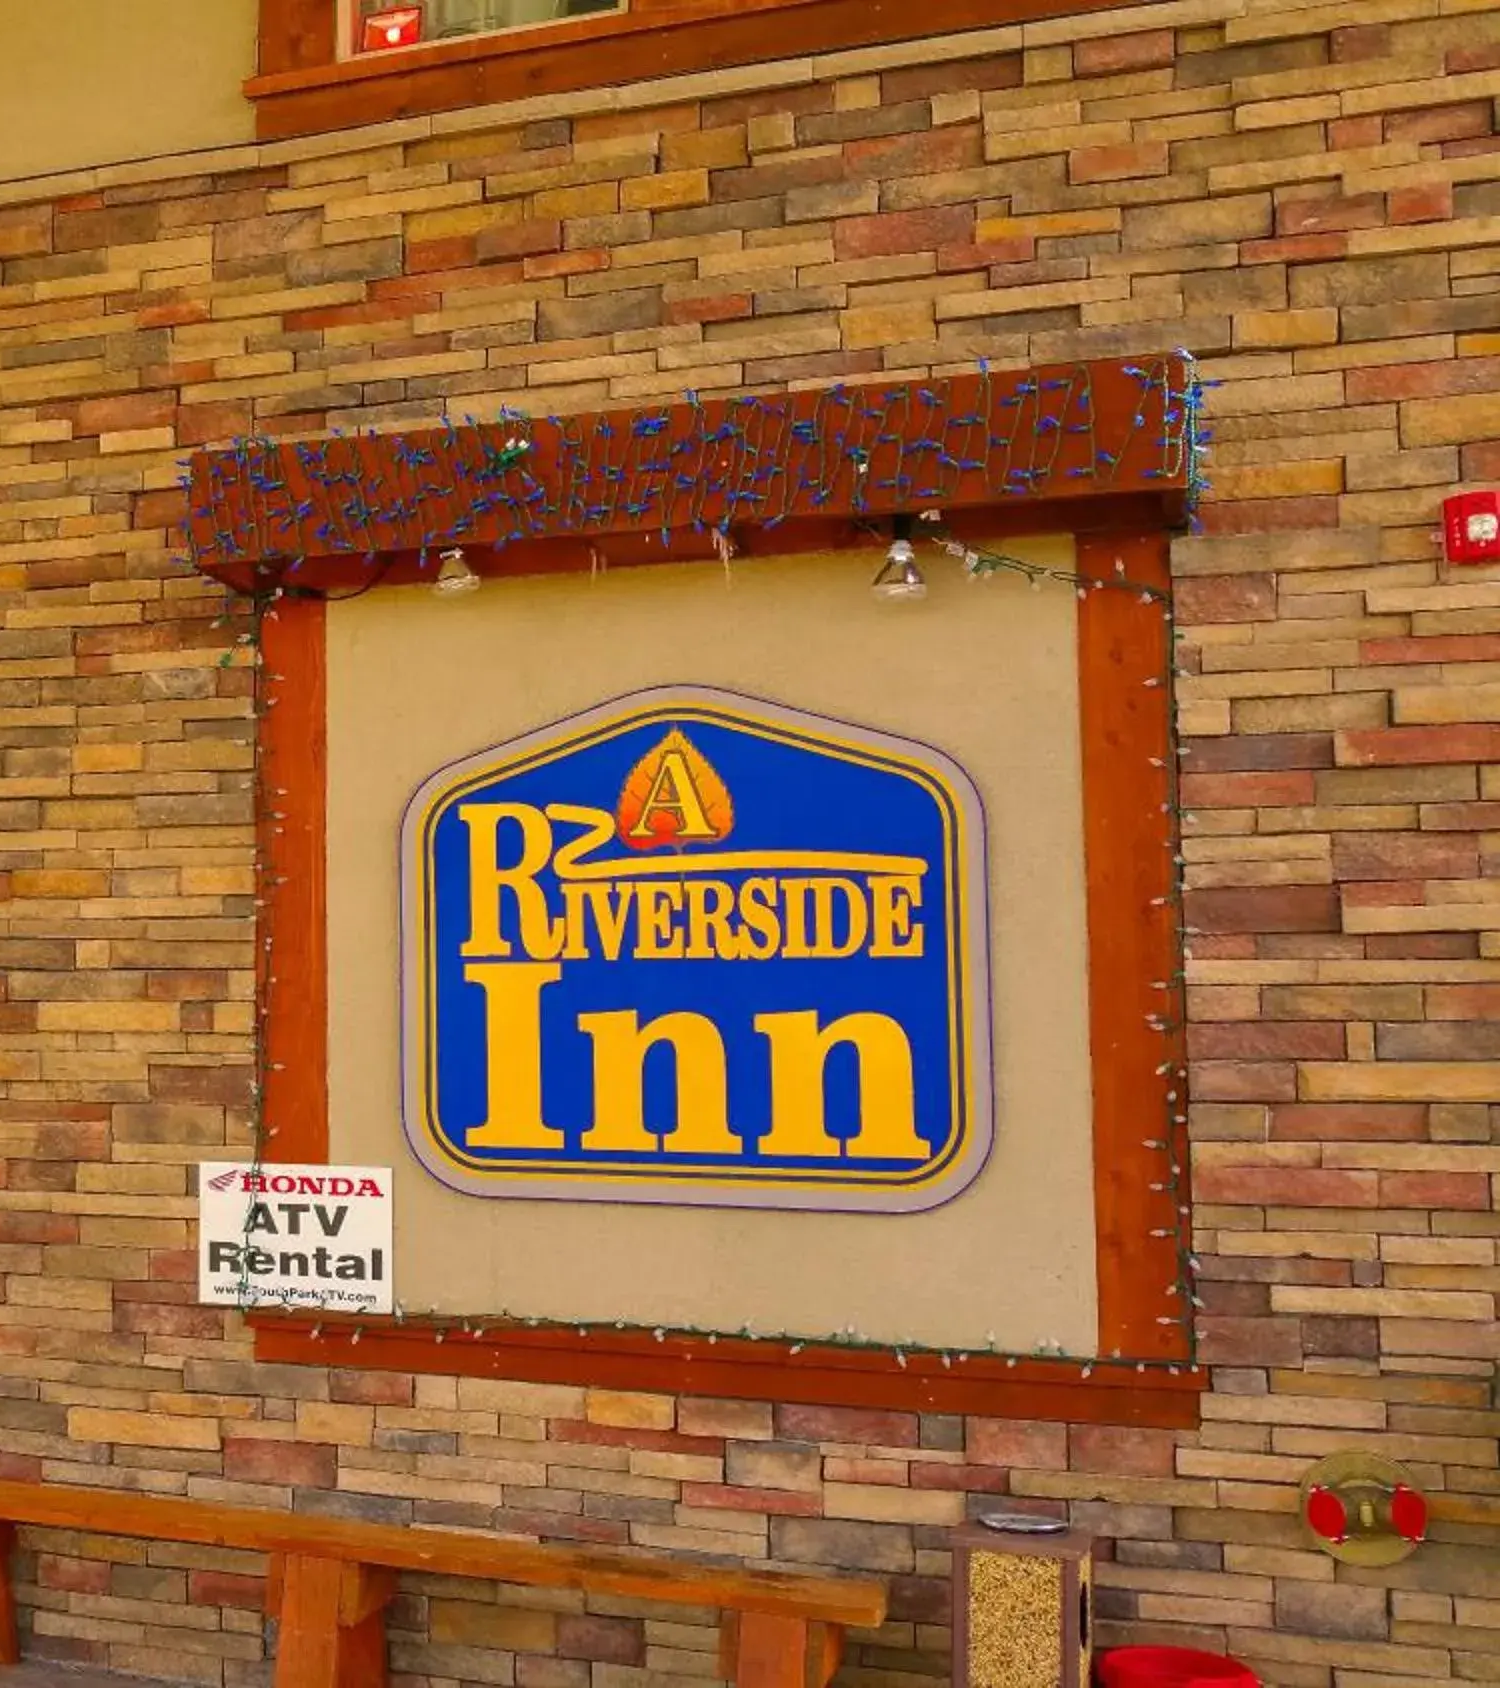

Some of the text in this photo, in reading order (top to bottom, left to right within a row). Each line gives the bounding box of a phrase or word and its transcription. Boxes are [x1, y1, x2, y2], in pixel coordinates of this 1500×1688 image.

[629, 750, 720, 840] A
[457, 801, 926, 961] RIVERSIDE
[463, 961, 931, 1160] Inn
[240, 1170, 385, 1199] HONDA
[244, 1202, 349, 1237] ATV
[208, 1240, 384, 1281] Rental
[213, 1284, 378, 1304] www.ouhParkTV.com
